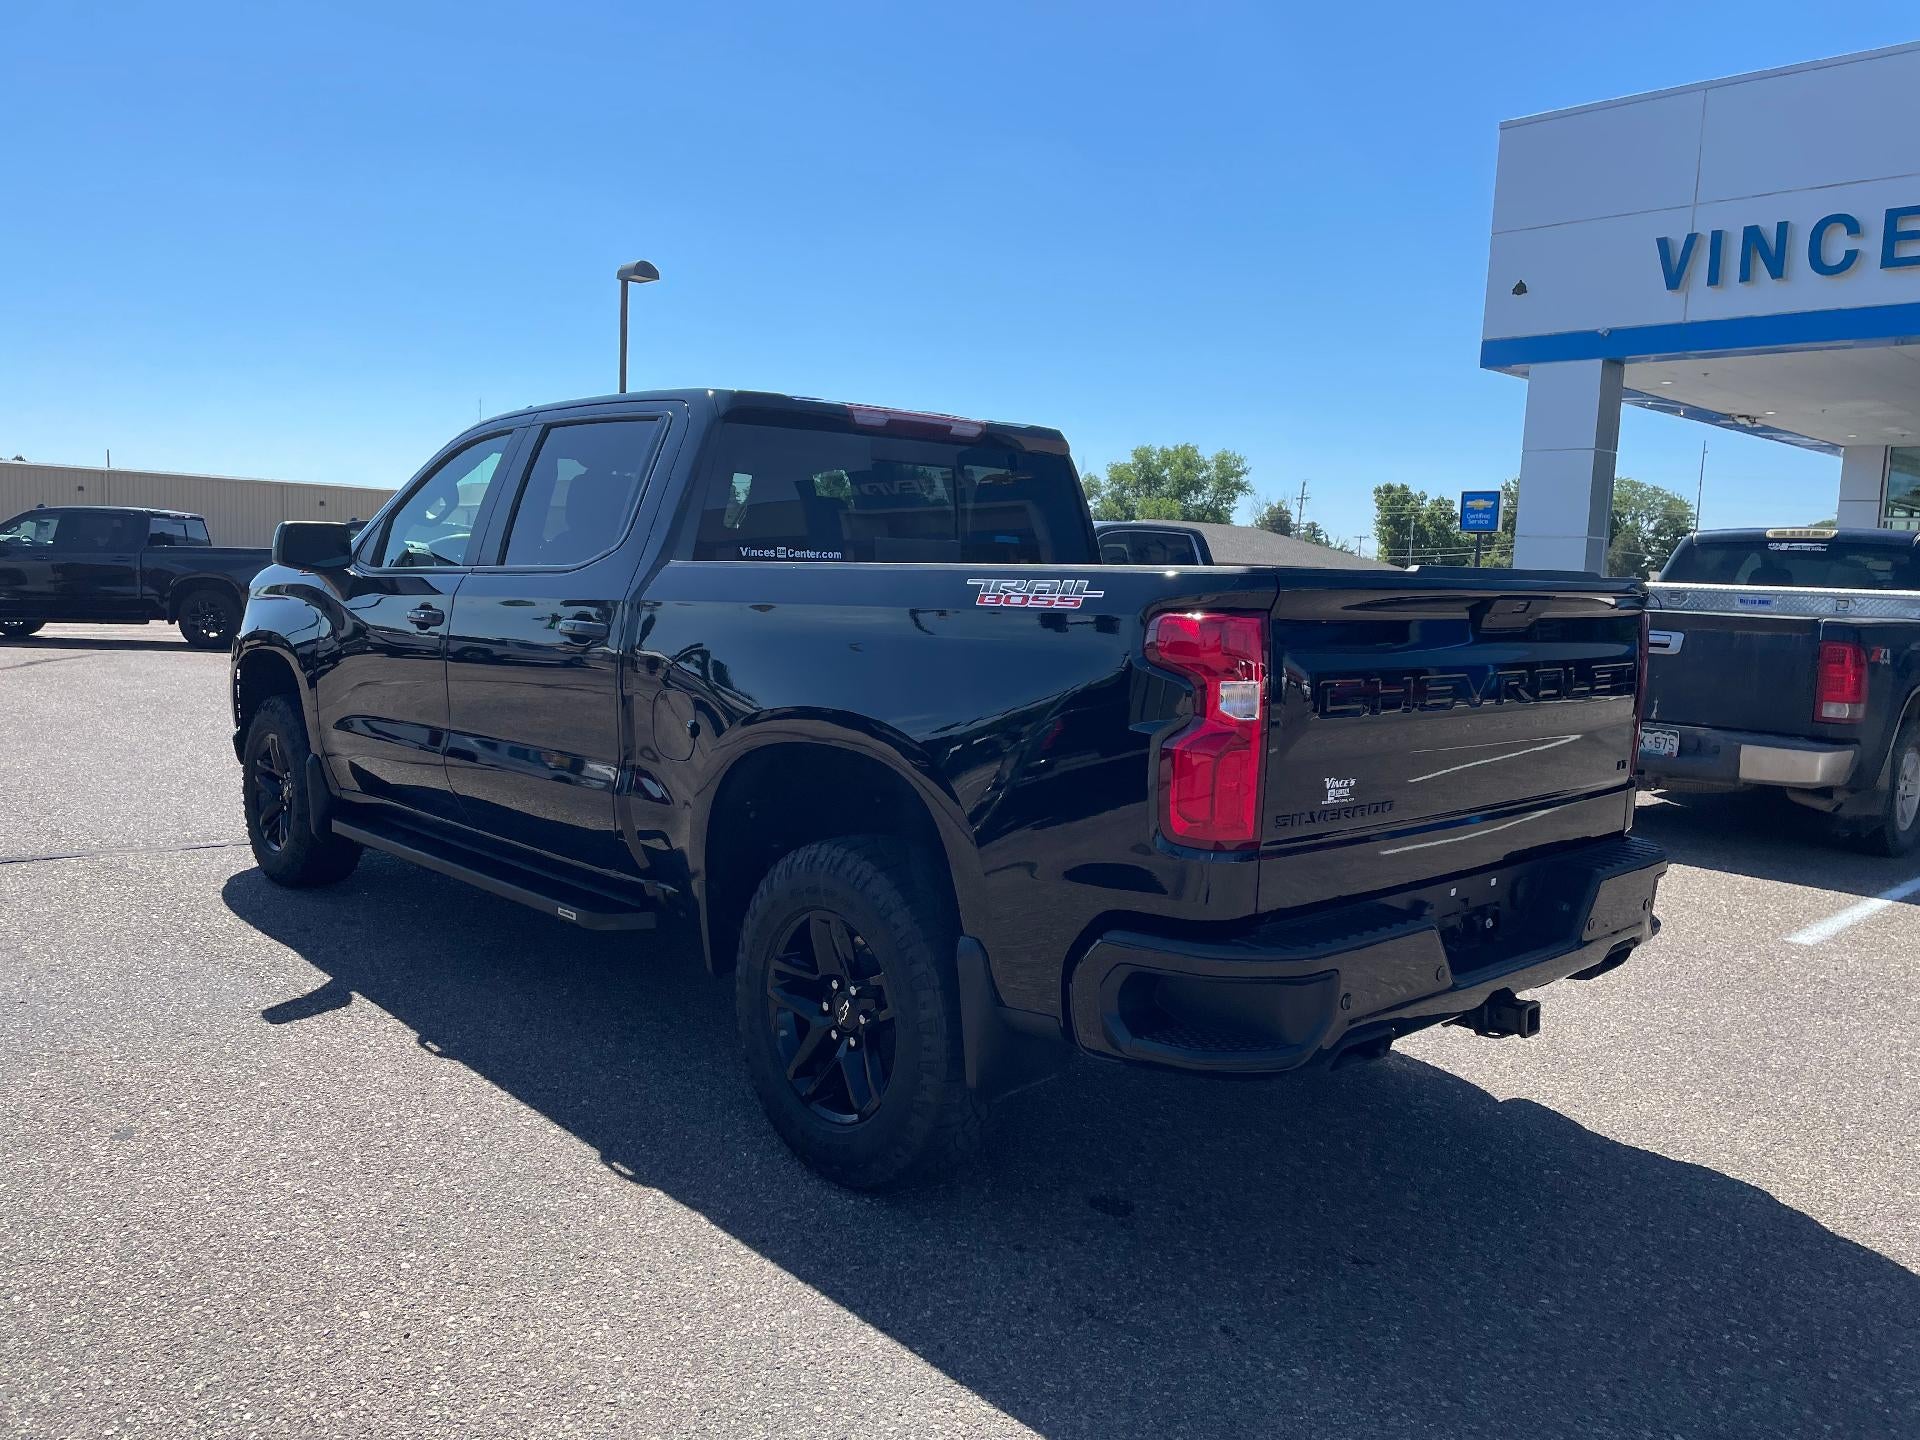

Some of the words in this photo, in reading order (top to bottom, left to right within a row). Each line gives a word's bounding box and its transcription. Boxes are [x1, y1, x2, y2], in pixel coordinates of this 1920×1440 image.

[1656, 205, 1920, 292] VINCE
[966, 578, 1104, 598] TRAIL
[975, 592, 1083, 609] BOSS
[1317, 663, 1635, 718] CHEVROLET
[1274, 800, 1395, 829] SILVERADO
